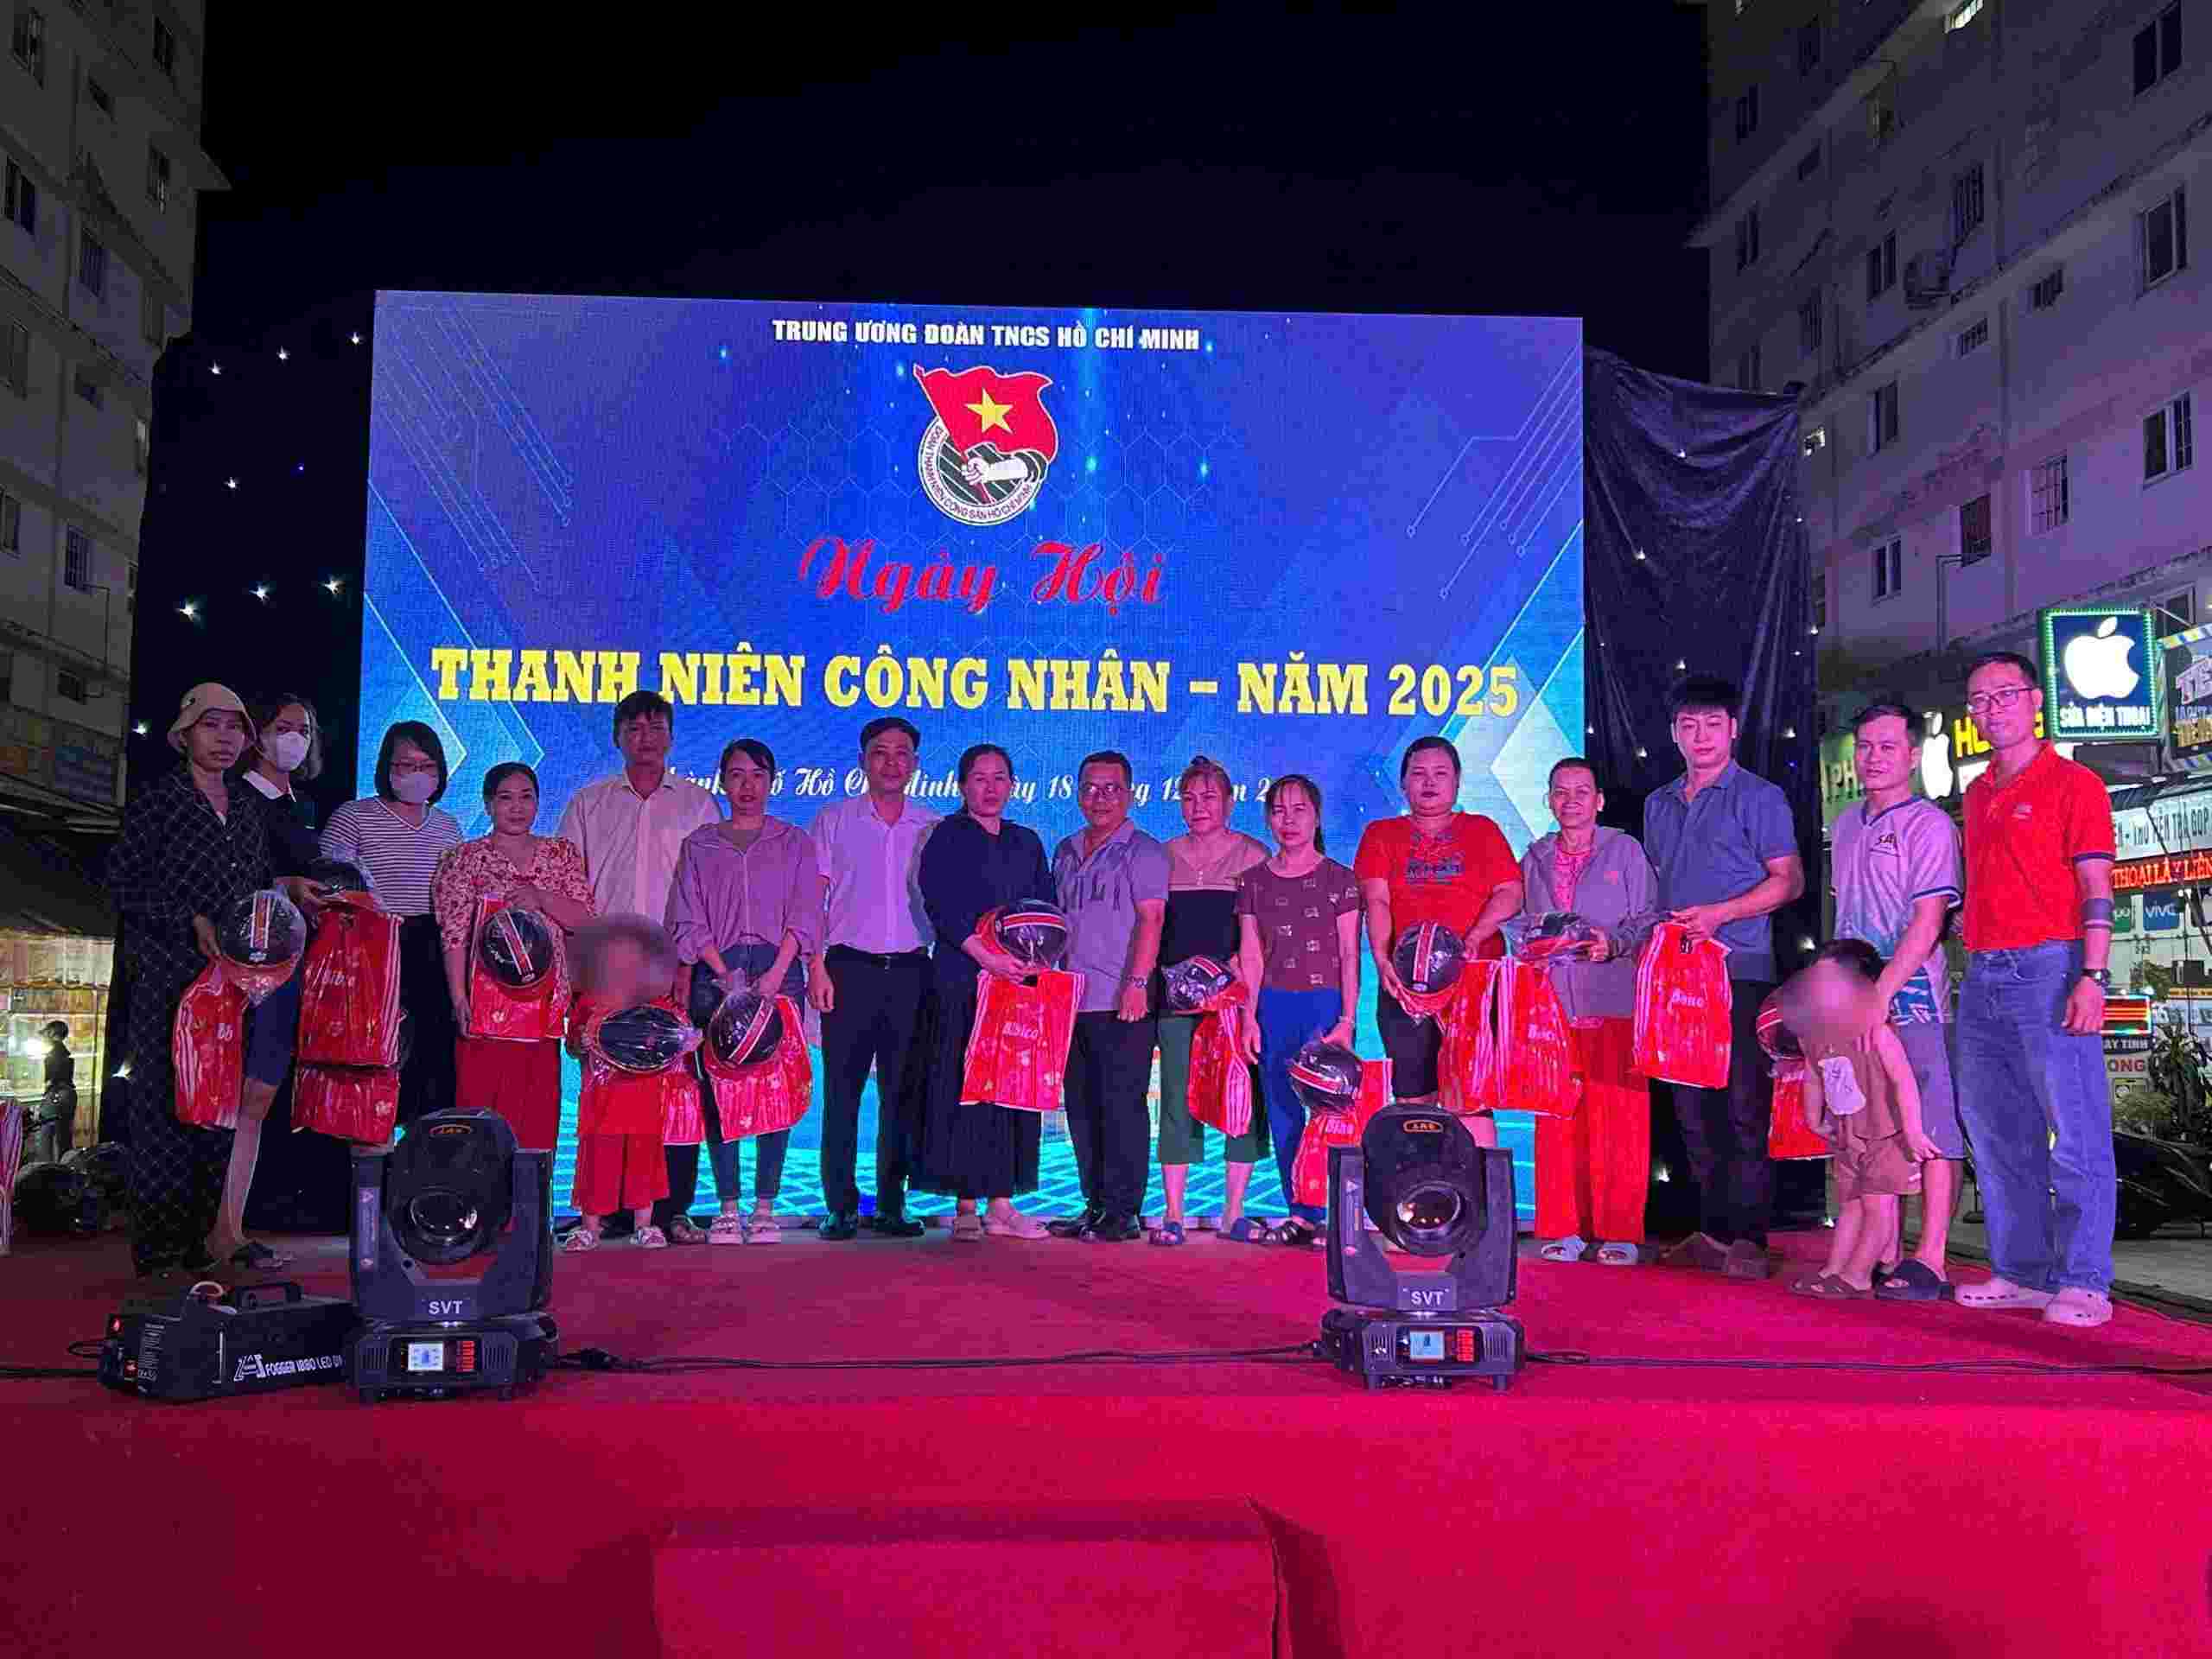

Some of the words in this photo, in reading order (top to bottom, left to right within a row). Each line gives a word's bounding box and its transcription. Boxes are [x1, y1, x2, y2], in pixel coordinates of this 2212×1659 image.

[772, 320, 848, 342] TRUNG
[855, 321, 917, 345] ƯƠNG
[925, 321, 984, 346] ĐOÀN
[991, 326, 1050, 347] TNCS
[1058, 321, 1087, 347] HỒ
[1095, 325, 1134, 348] CHÍ
[1141, 328, 1199, 350] MINH
[798, 537, 997, 613] Ngày
[1031, 542, 1163, 615] Hội
[431, 647, 640, 702] THANH
[659, 642, 805, 707] NIÊN
[823, 644, 988, 709] CÔNG
[1007, 649, 1171, 713] NHÂN
[1237, 651, 1369, 715] NĂM
[1388, 663, 1520, 716] 2025
[794, 767, 836, 796] Hồ
[1048, 774, 1074, 799] 18
[428, 1300, 464, 1314] SVT
[1410, 1291, 1445, 1306] SVT
